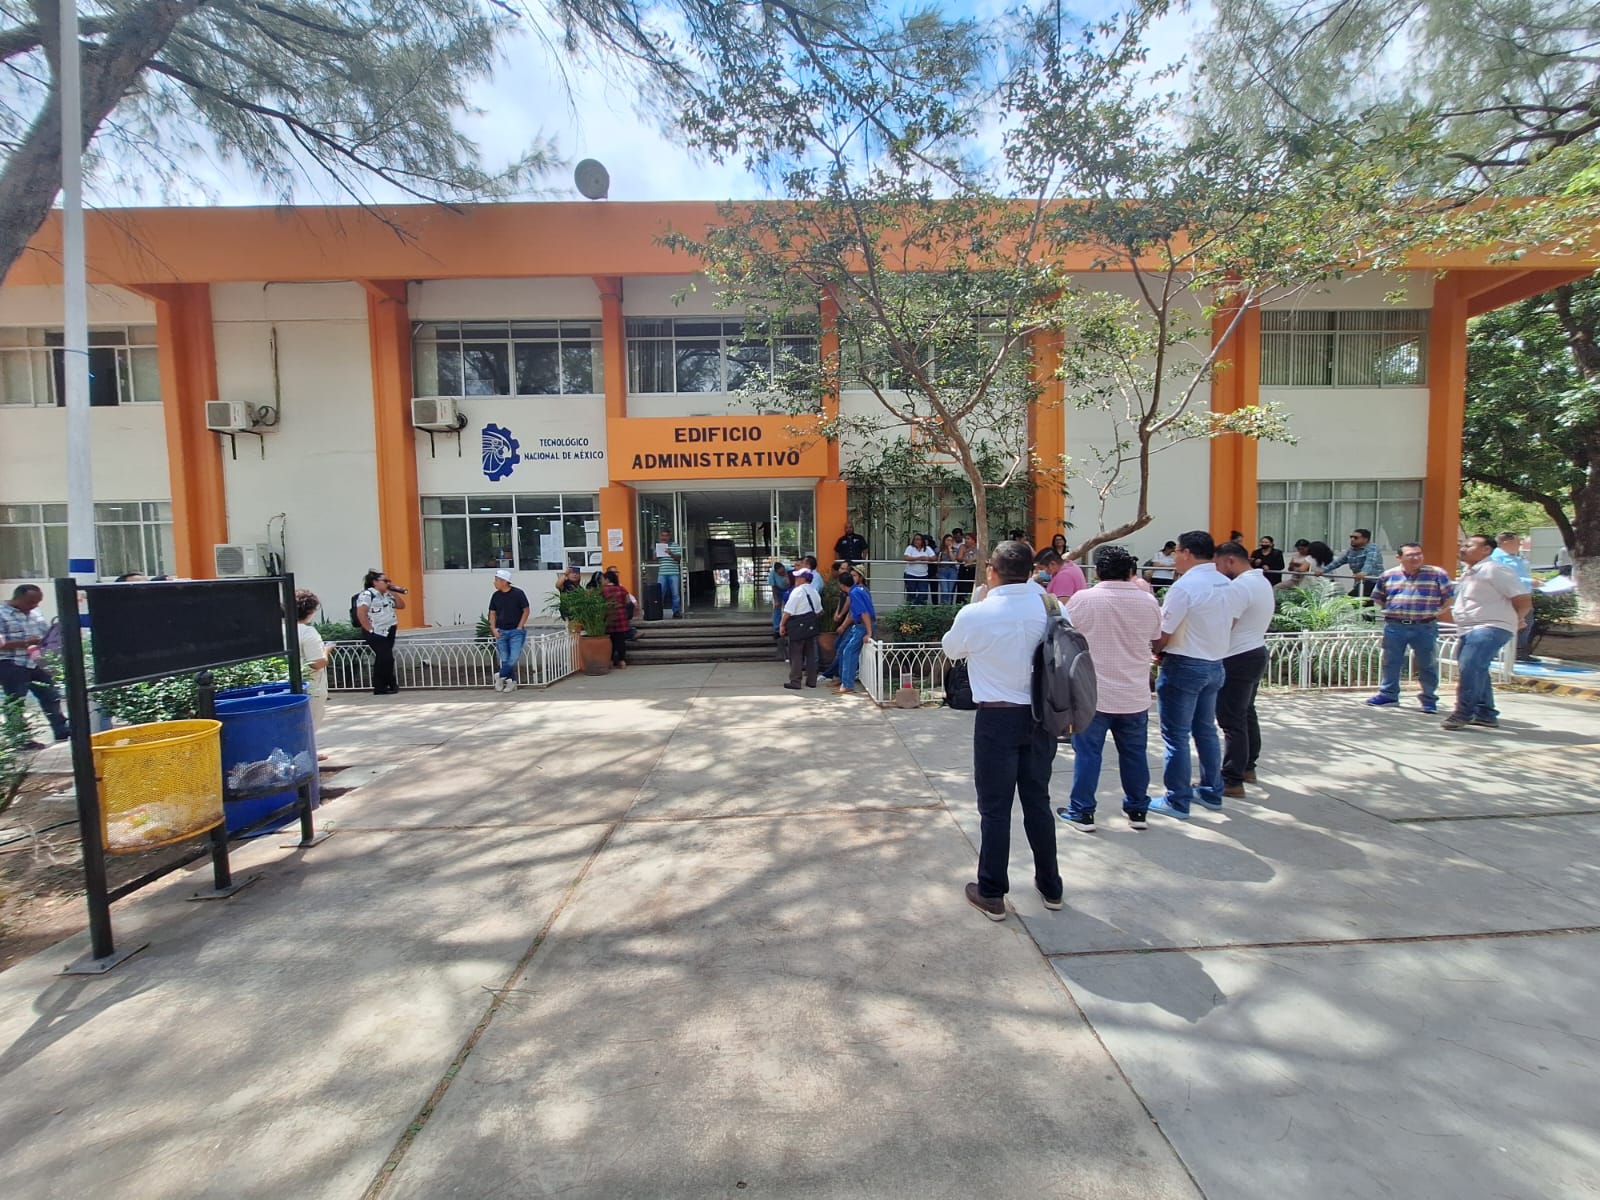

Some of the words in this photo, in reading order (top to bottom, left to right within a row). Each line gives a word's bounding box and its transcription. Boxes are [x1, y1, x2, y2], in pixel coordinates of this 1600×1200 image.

[674, 426, 762, 443] EDIFICIO
[539, 437, 589, 447] TECNOLÓGICO
[524, 451, 560, 461] NACIONAL
[562, 451, 571, 460] DE
[573, 449, 604, 460] MÉXICO
[631, 451, 800, 470] ADMINISTRATIVO
